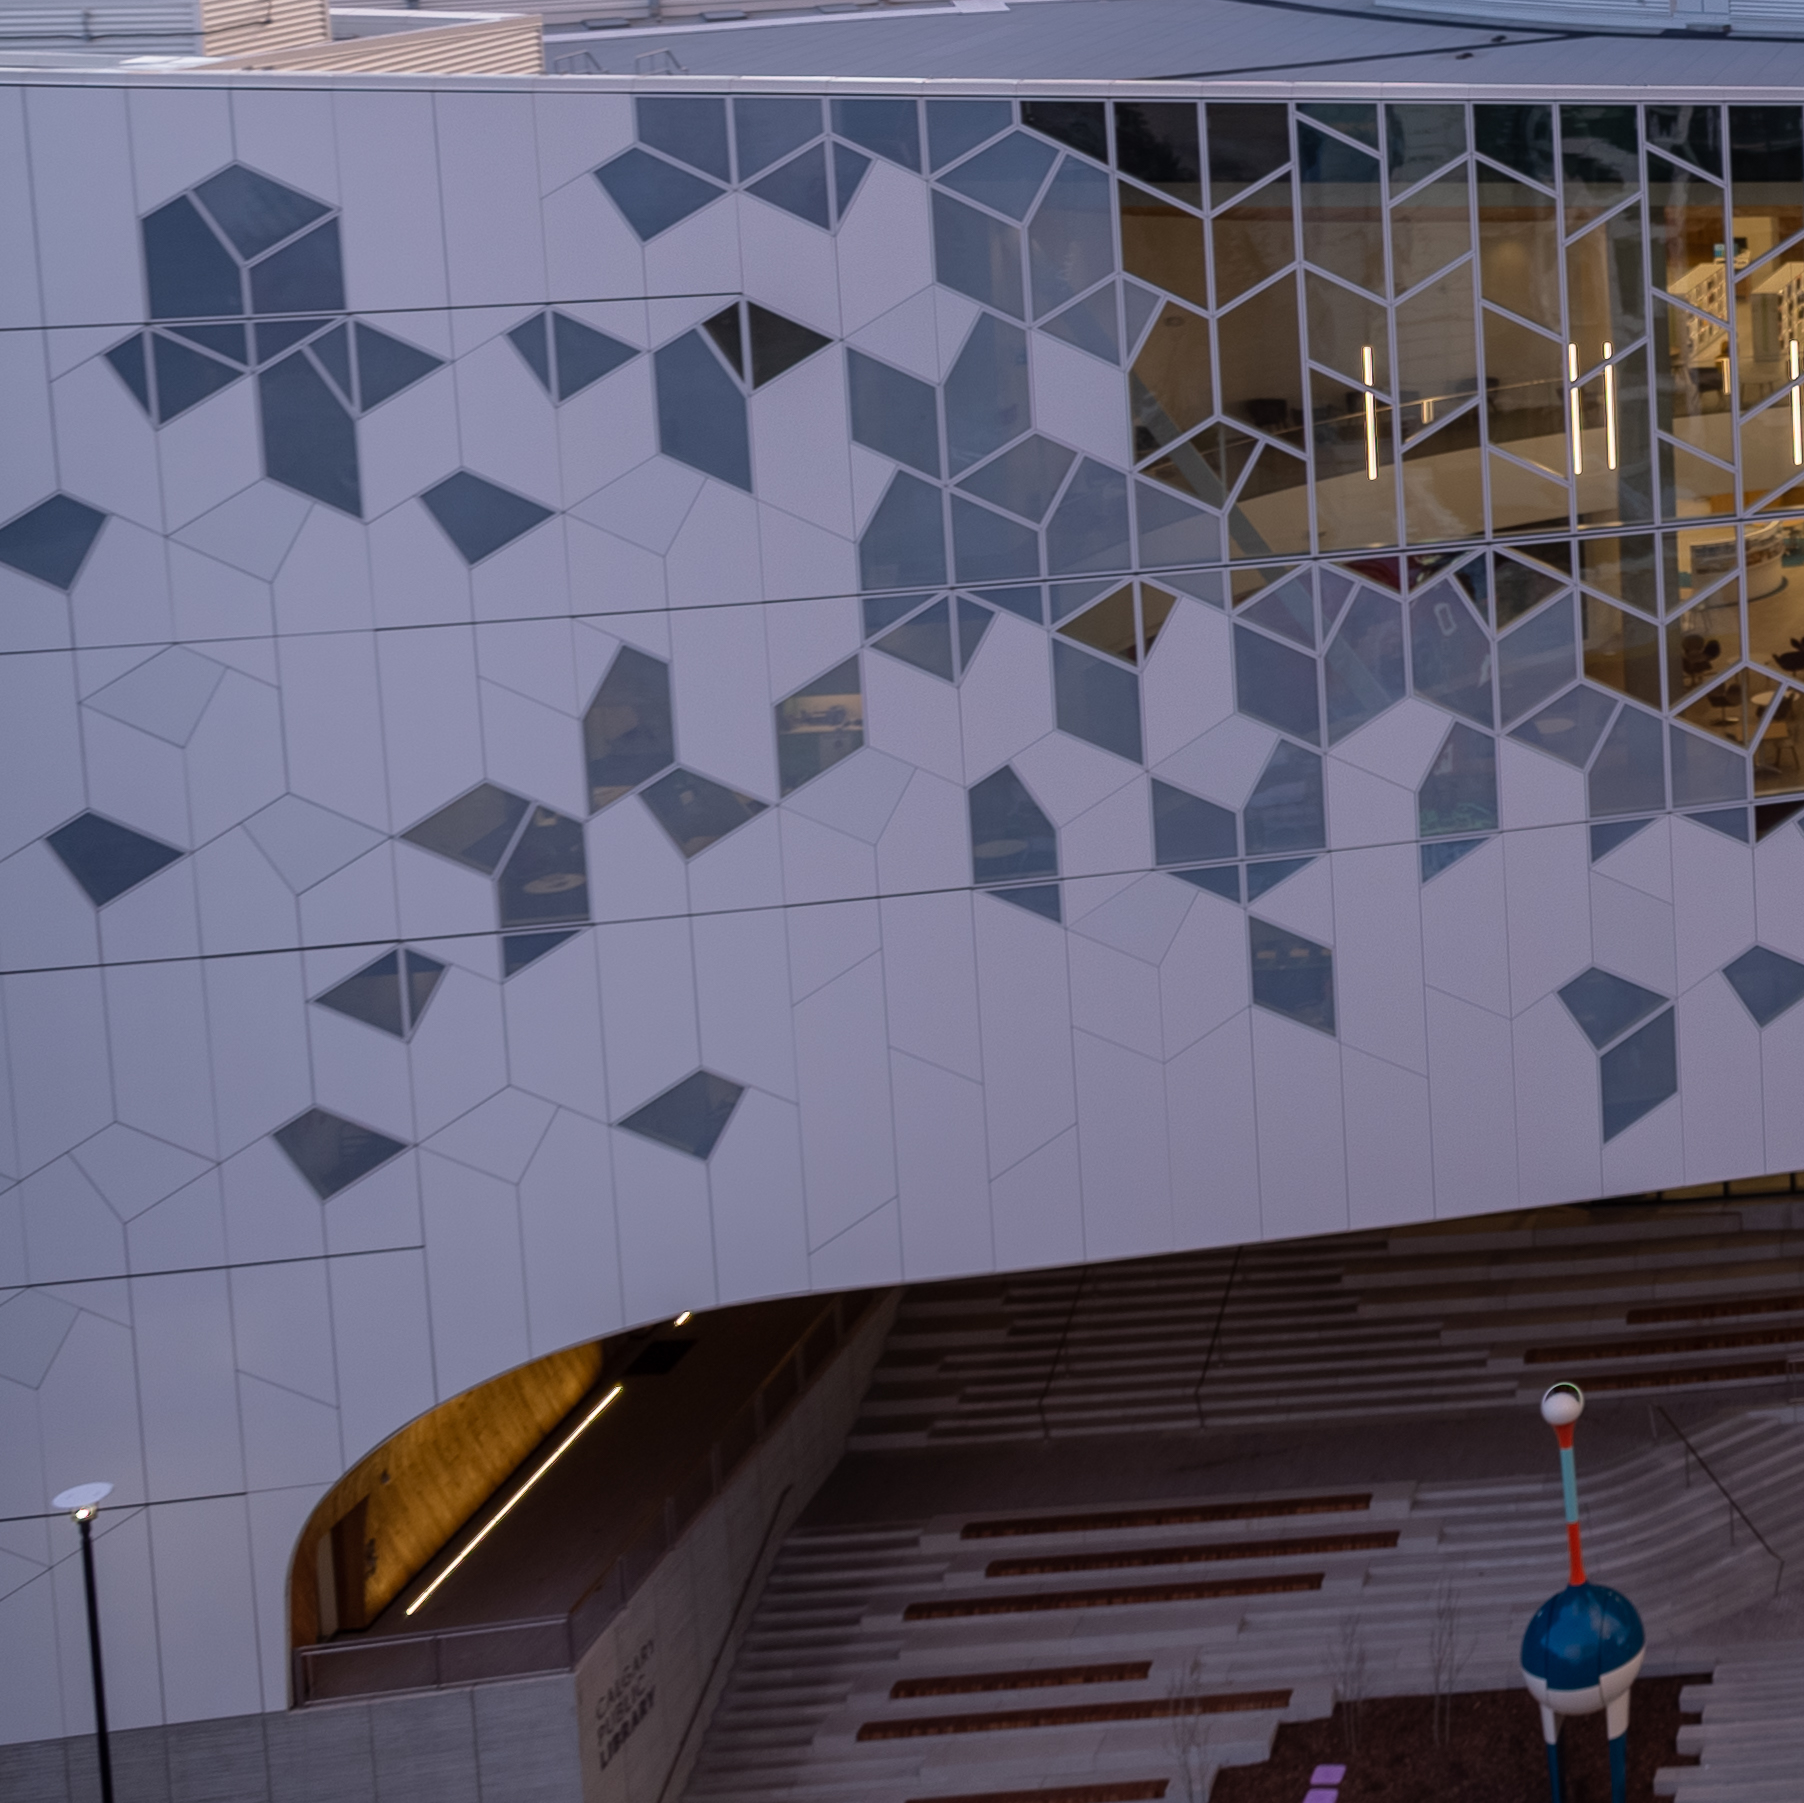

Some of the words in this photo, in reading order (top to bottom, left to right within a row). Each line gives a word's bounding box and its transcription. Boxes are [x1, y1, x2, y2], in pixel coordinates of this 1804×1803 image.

[596, 1639, 655, 1721] CALGARY
[597, 1673, 646, 1747] PUBLIC
[600, 1684, 656, 1771] LIBRARY
